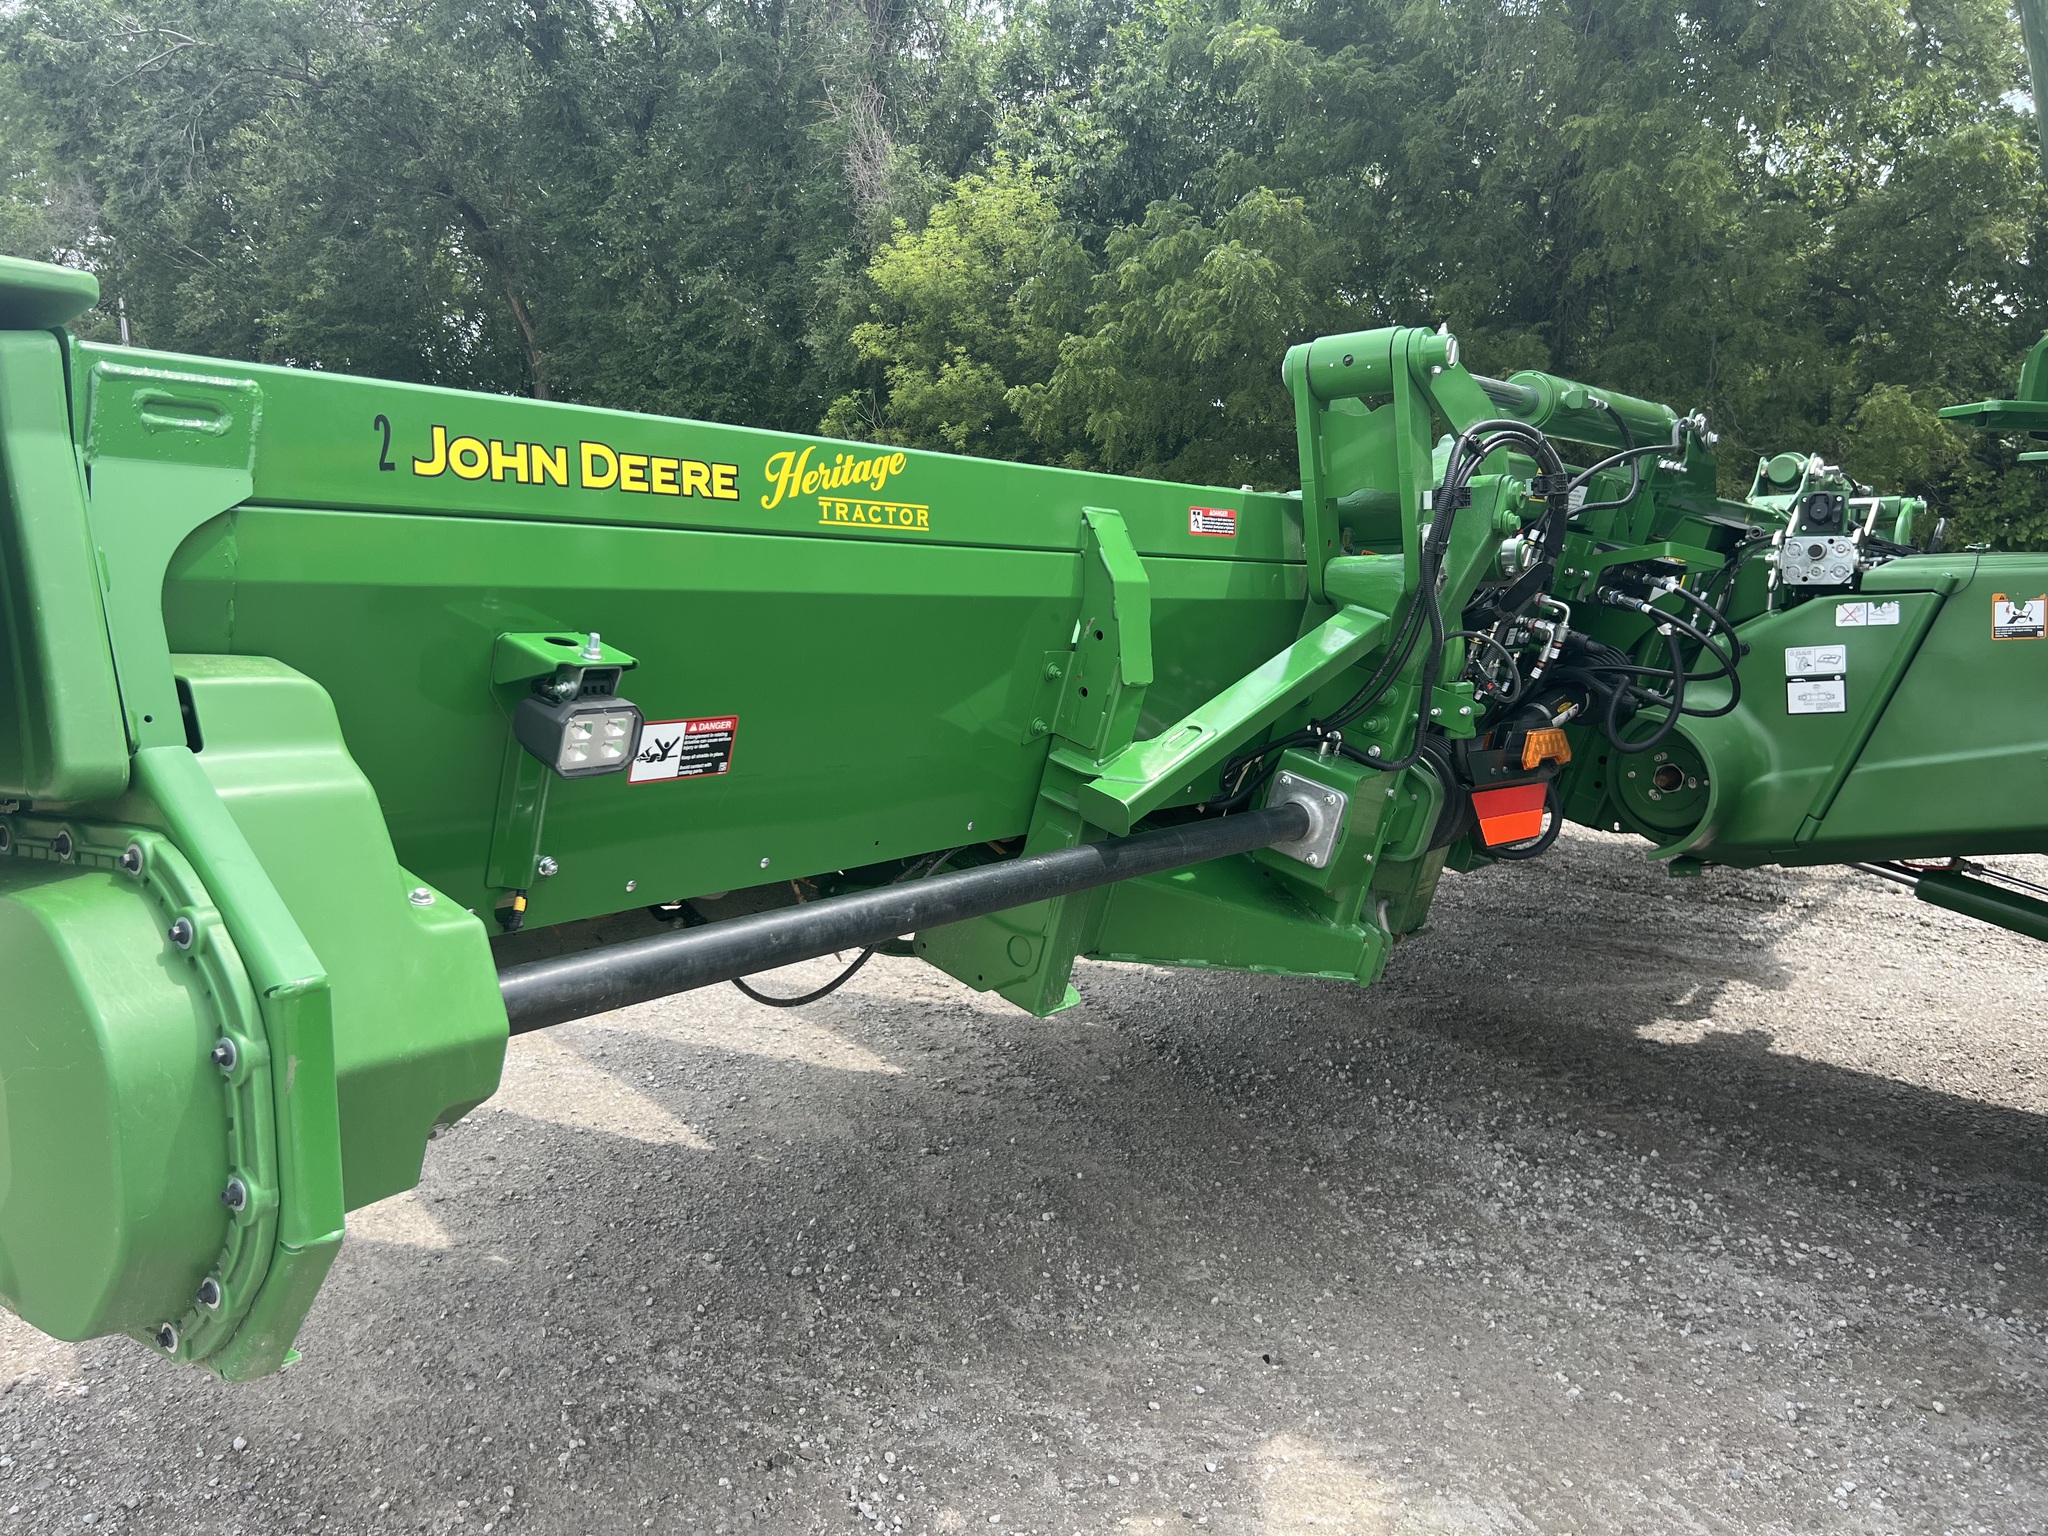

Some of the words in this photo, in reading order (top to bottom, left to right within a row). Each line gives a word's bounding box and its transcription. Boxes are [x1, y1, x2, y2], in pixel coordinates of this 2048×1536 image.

[373, 413, 396, 472] 2
[412, 424, 569, 487] JOHN
[579, 440, 740, 501] DEERE
[761, 445, 907, 510] Heritage
[818, 501, 929, 527] TRACTOR
[698, 721, 732, 731] DANGER
